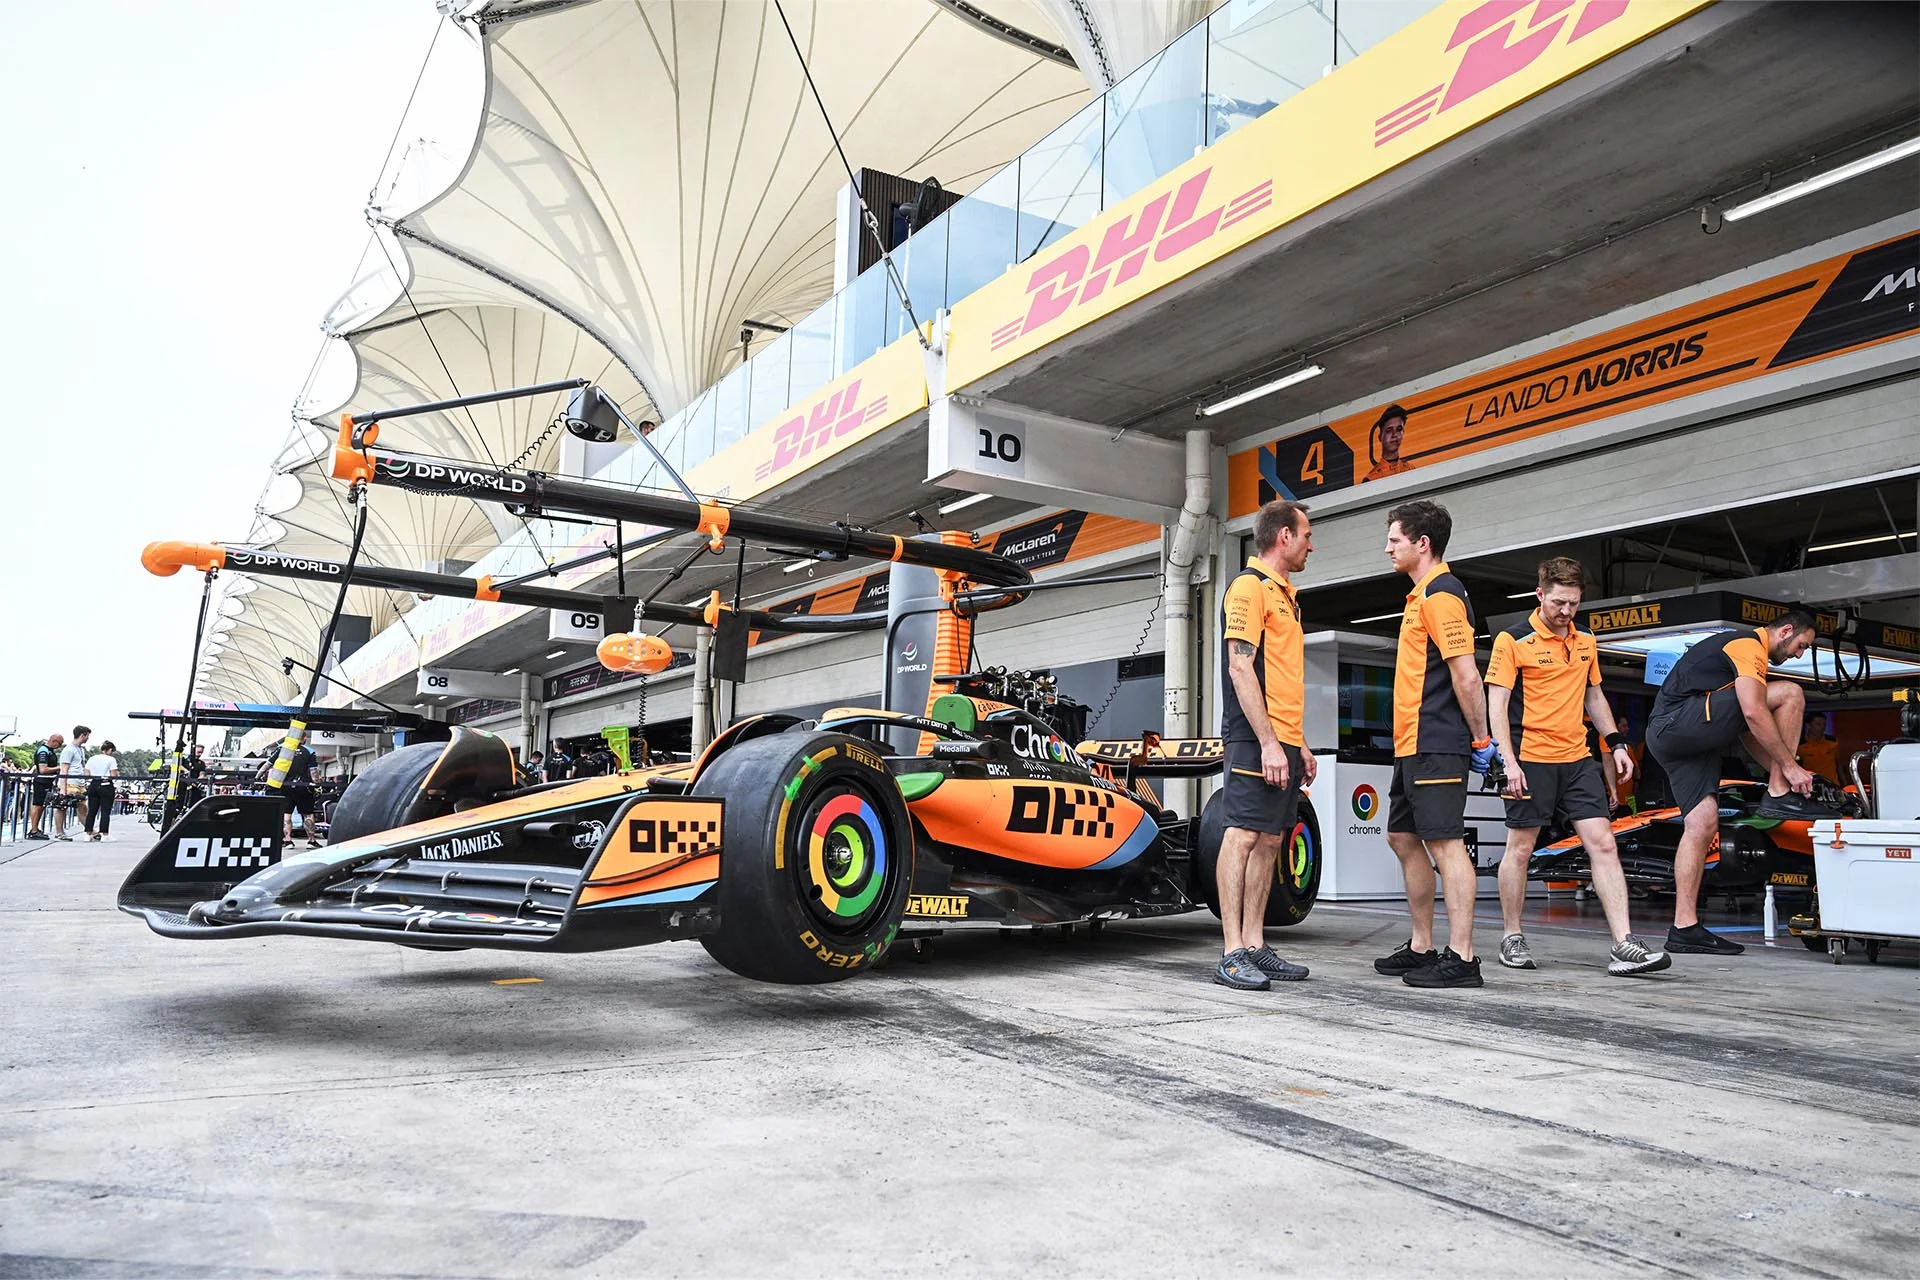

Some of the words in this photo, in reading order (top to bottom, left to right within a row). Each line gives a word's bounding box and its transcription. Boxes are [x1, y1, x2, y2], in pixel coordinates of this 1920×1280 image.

[1020, 166, 1225, 336] DHL
[1464, 375, 1568, 427] LANDO
[1573, 331, 1708, 396] NORRIS
[770, 379, 867, 474] DHL
[979, 428, 1021, 462] 10
[1300, 440, 1324, 485] 4
[415, 464, 445, 478] DP
[449, 468, 526, 493] WORLD
[1002, 533, 1056, 557] McLaren
[1041, 549, 1056, 559] TEAM
[255, 554, 277, 566] DP
[280, 558, 340, 574] WORLD
[571, 613, 599, 629] 09
[897, 665, 905, 674] DP
[905, 663, 927, 673] WORLD
[427, 676, 448, 688] 08
[940, 745, 970, 753] Medallia
[1005, 786, 1115, 838] OKX
[629, 820, 716, 853] OKX
[1349, 823, 1381, 835] chrome
[174, 838, 272, 867] OKX
[1887, 849, 1910, 858] YETI
